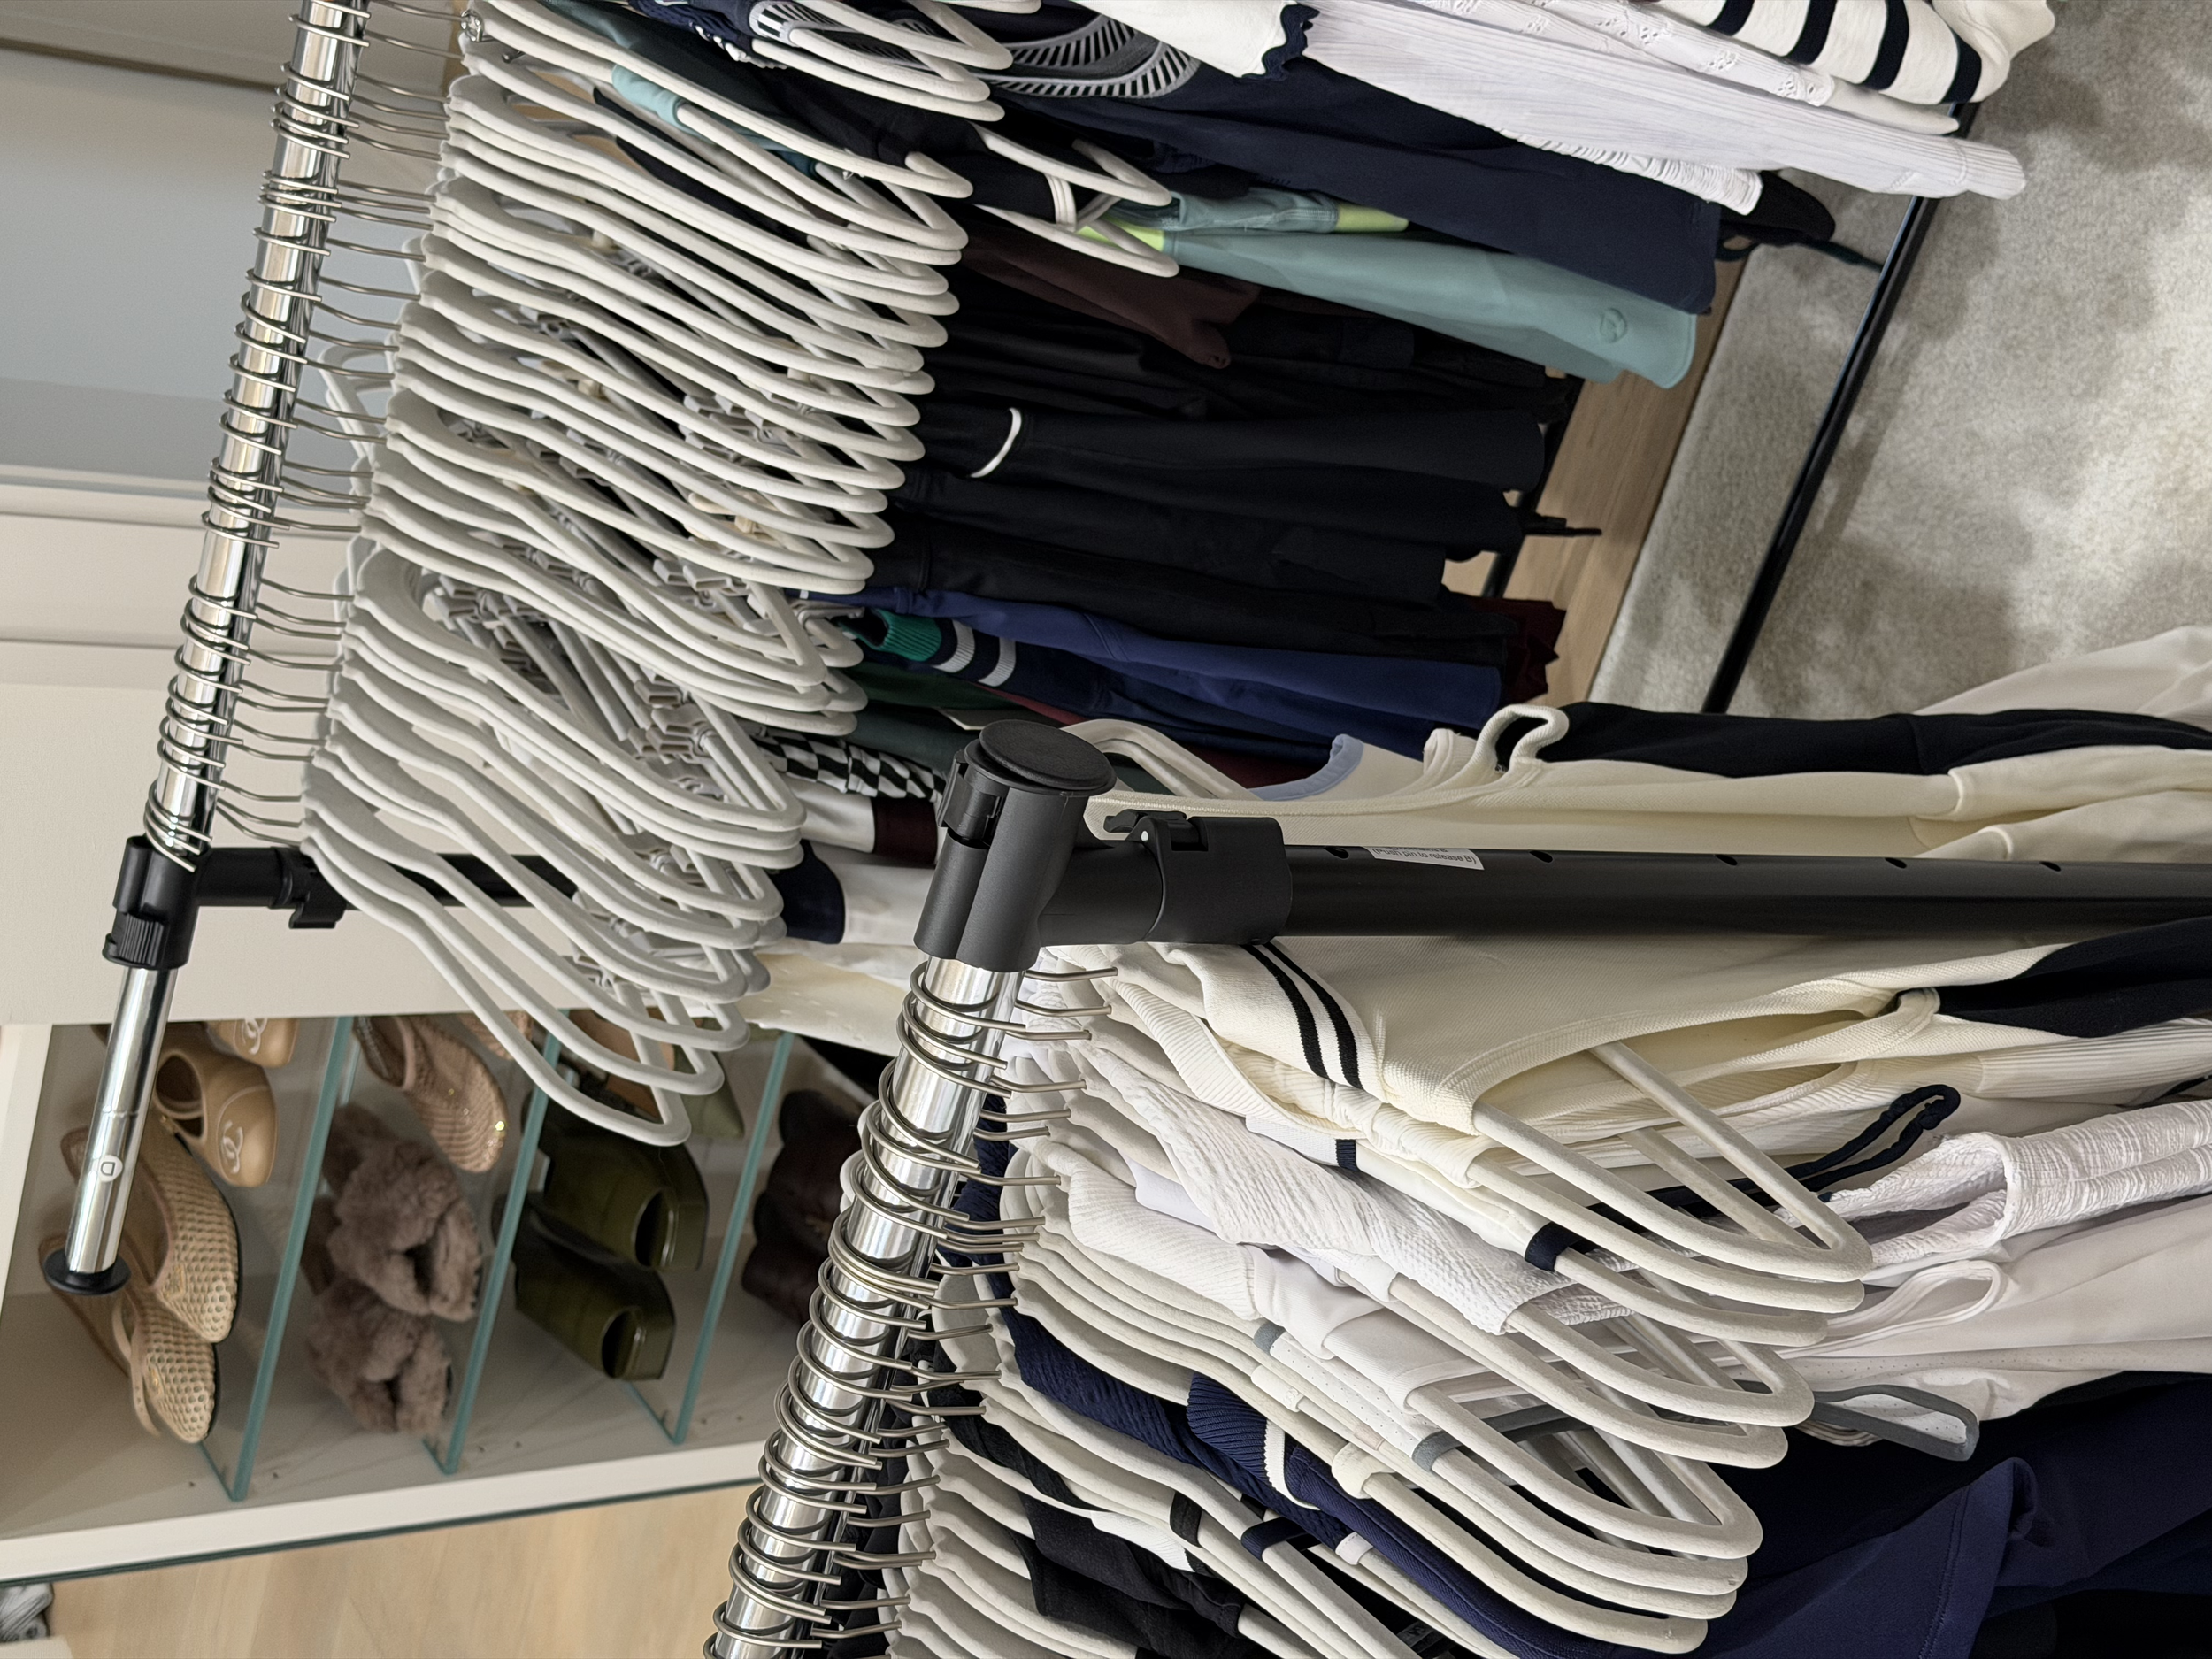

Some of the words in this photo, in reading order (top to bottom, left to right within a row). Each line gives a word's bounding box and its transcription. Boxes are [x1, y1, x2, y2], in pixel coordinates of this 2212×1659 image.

[1371, 848, 1402, 856] (Push
[1464, 855, 1476, 864] B)
[101, 1162, 116, 1176] D
